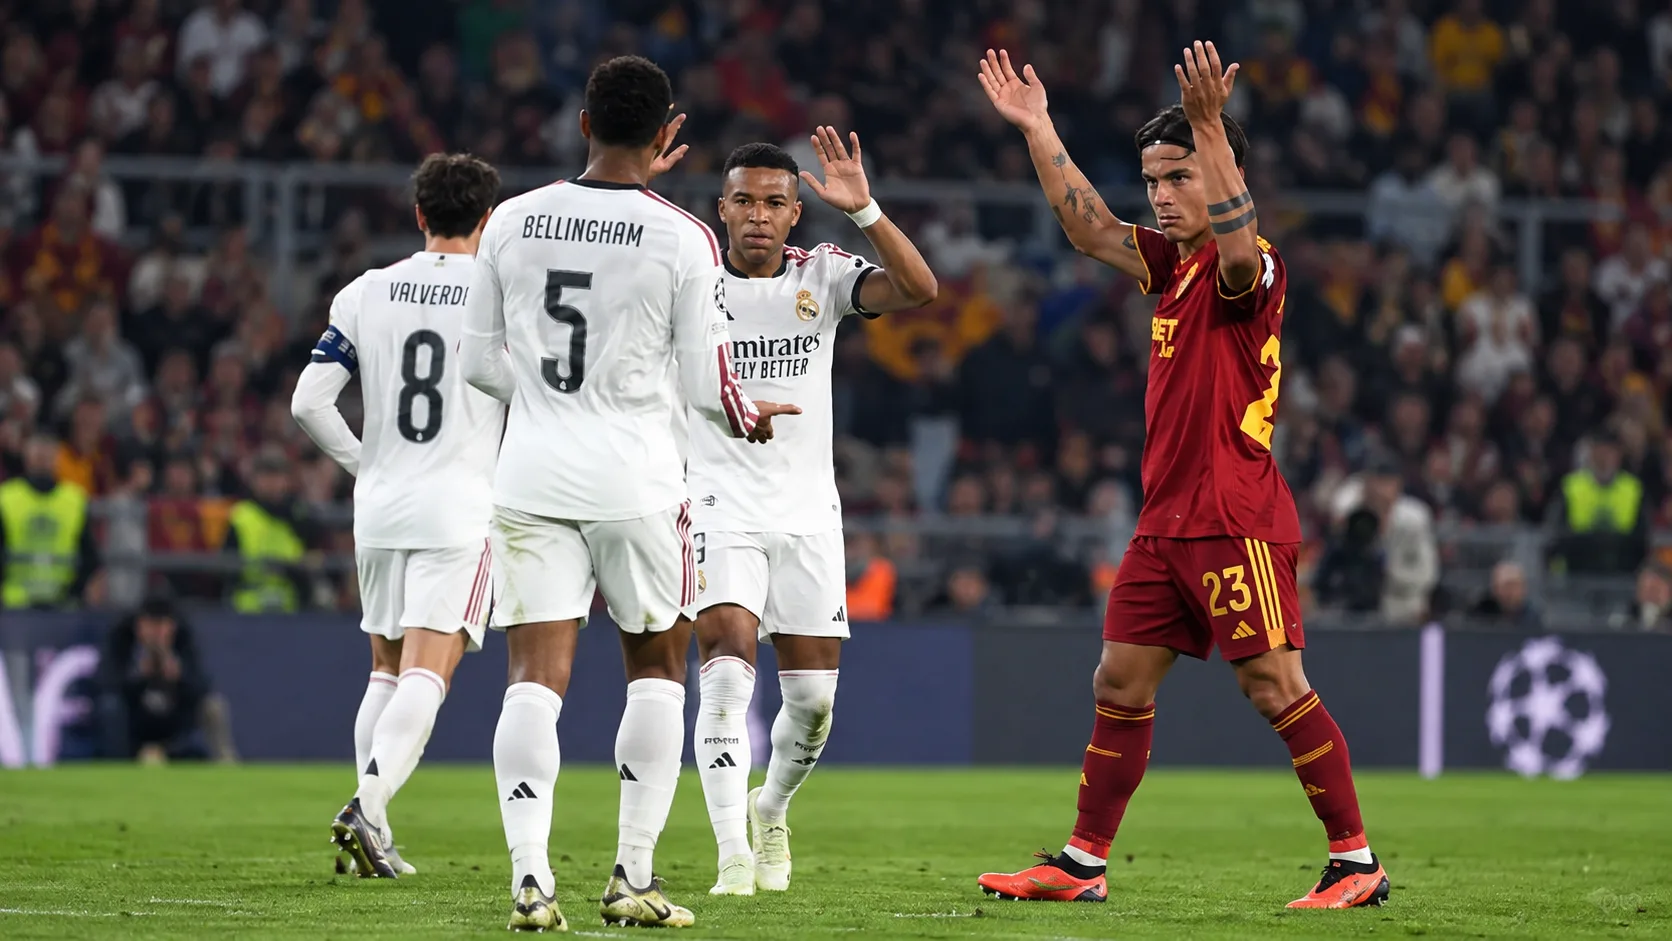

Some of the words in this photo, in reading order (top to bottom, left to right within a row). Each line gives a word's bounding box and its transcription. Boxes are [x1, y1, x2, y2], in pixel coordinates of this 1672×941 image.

[521, 214, 645, 248] BELLINGHAM
[540, 268, 593, 394] 5
[729, 332, 821, 359] mirates
[397, 328, 446, 445] 8
[760, 357, 809, 380] BETTER
[1202, 564, 1252, 617] 23
